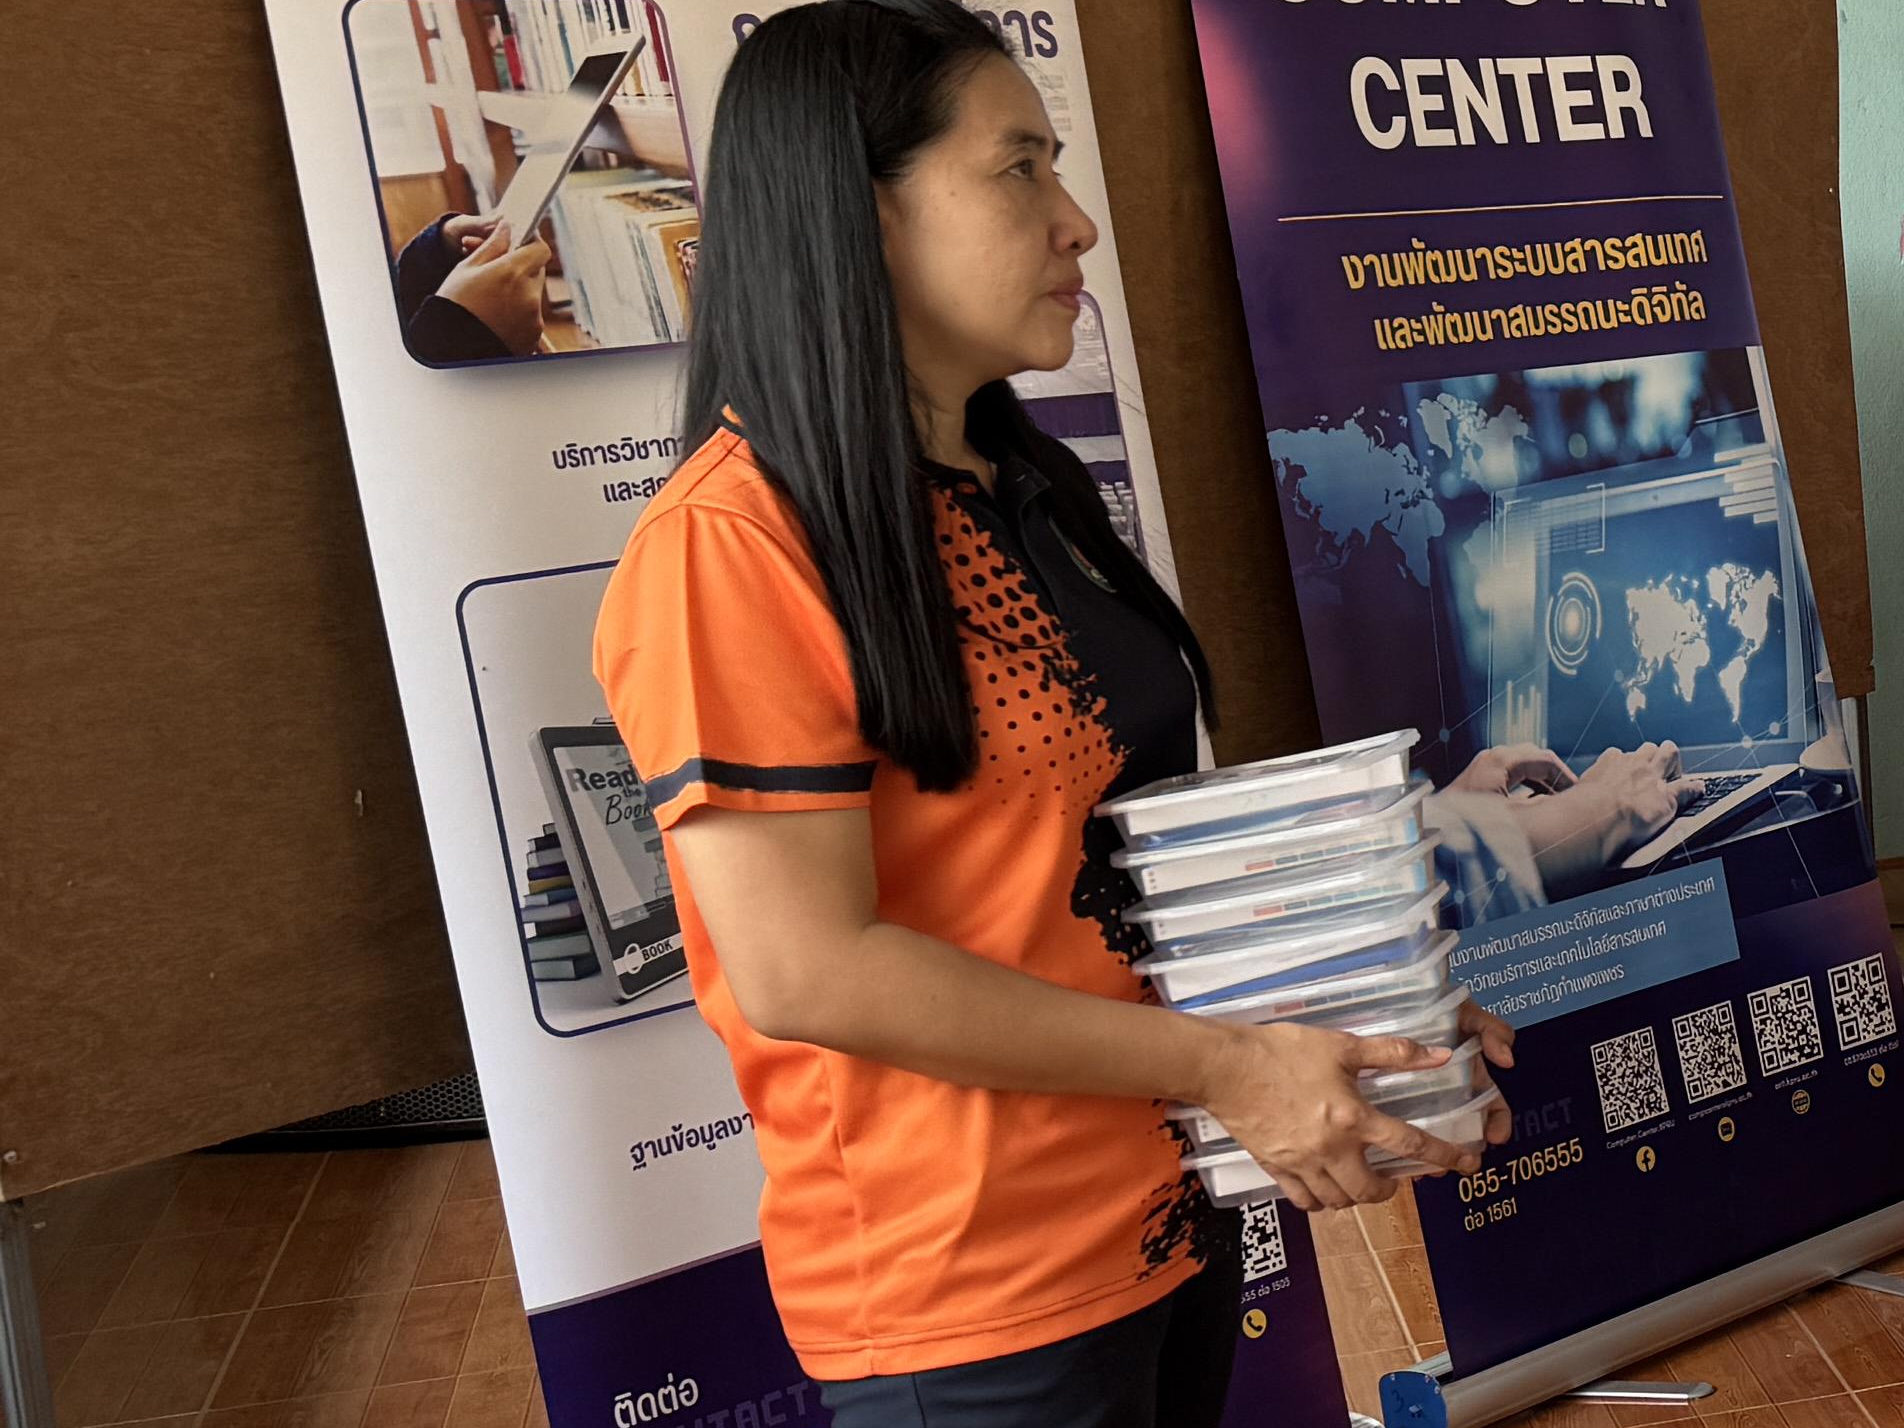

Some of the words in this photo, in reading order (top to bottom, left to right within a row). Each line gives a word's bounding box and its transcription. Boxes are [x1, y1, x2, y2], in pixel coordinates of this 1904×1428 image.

[1349, 55, 1654, 150] CENTER
[1342, 229, 1707, 291] งานพัฒนาระบบสารสนเทศ
[1374, 283, 1707, 351] และพัฒนาสมรรถนะดิจิทัล
[566, 764, 638, 793] Read
[1458, 1137, 1584, 1202] 055-706555
[1464, 1208, 1484, 1231] ต่อ
[1487, 1197, 1518, 1222] 1561
